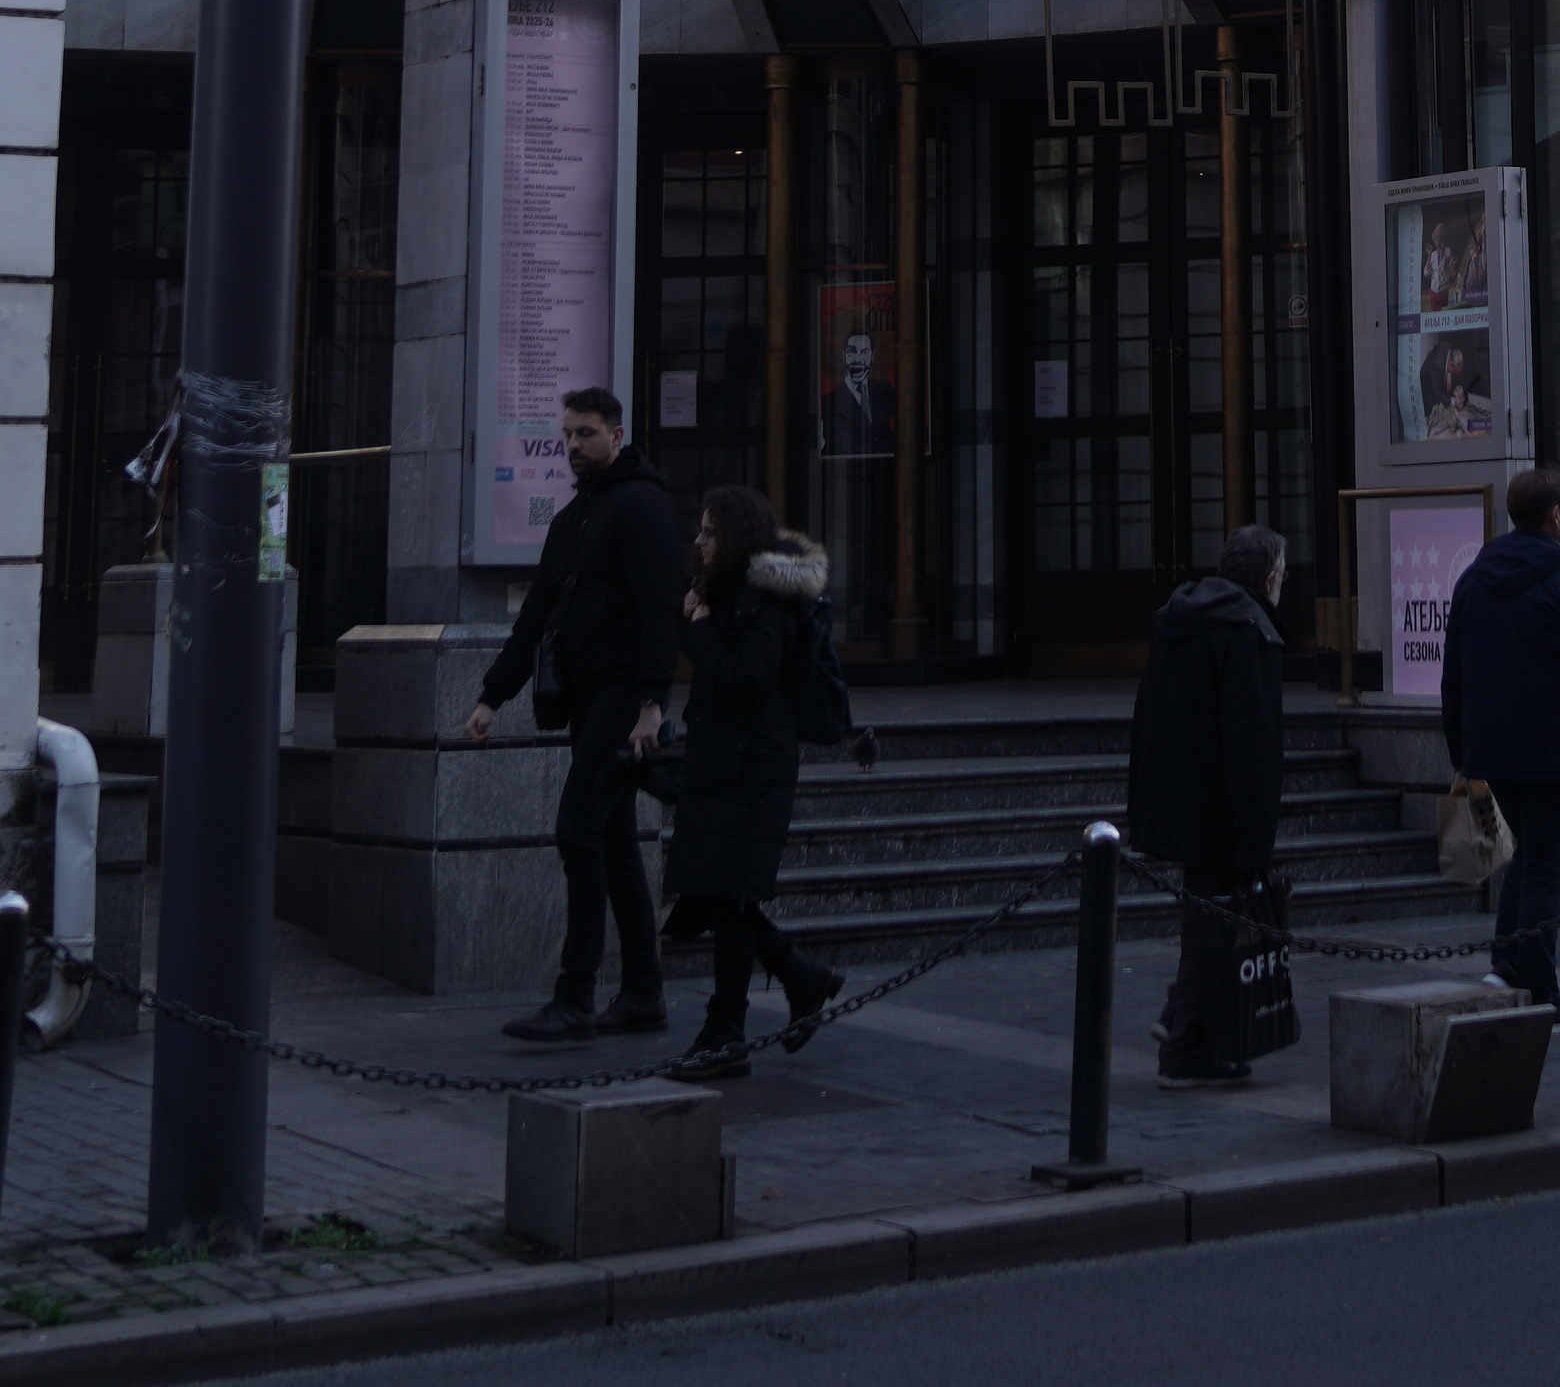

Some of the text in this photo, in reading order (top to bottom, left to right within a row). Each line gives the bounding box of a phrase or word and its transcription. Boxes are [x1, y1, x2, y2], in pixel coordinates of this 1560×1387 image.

[525, 15, 555, 27] 2025-26
[521, 439, 566, 457] VISA
[1403, 599, 1451, 632] АТЕЉЕ
[1403, 641, 1441, 662] СЕЗОНА
